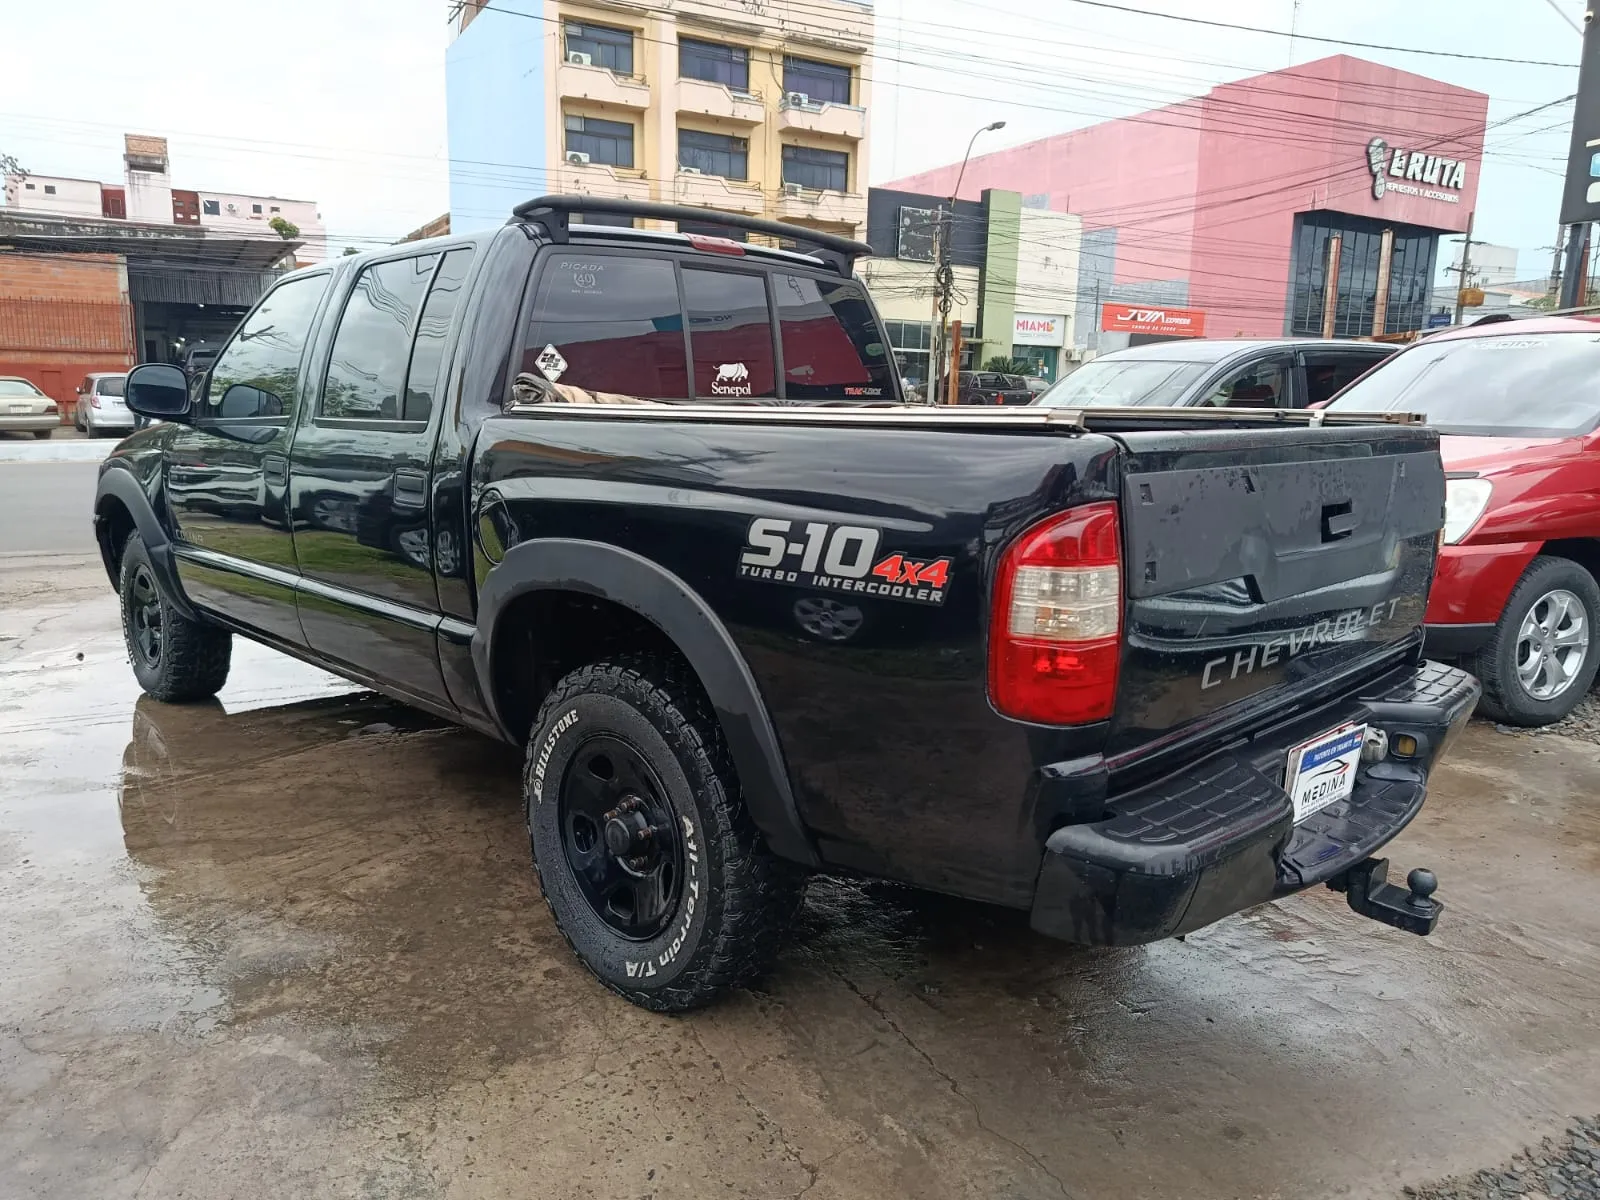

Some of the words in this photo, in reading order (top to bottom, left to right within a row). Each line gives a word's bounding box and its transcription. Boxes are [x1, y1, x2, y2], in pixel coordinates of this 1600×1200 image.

[1406, 152, 1466, 189] RUTA
[560, 262, 604, 271] PICADA
[711, 381, 752, 397] Senepol
[741, 518, 880, 578] S-10
[740, 565, 798, 583] TURBO
[812, 575, 943, 602] INTERCOOLER
[872, 554, 950, 588] 4x4
[1200, 597, 1401, 690] CHEVROLET
[535, 709, 579, 778] BILLSTONE
[1301, 773, 1346, 806] MEDINA
